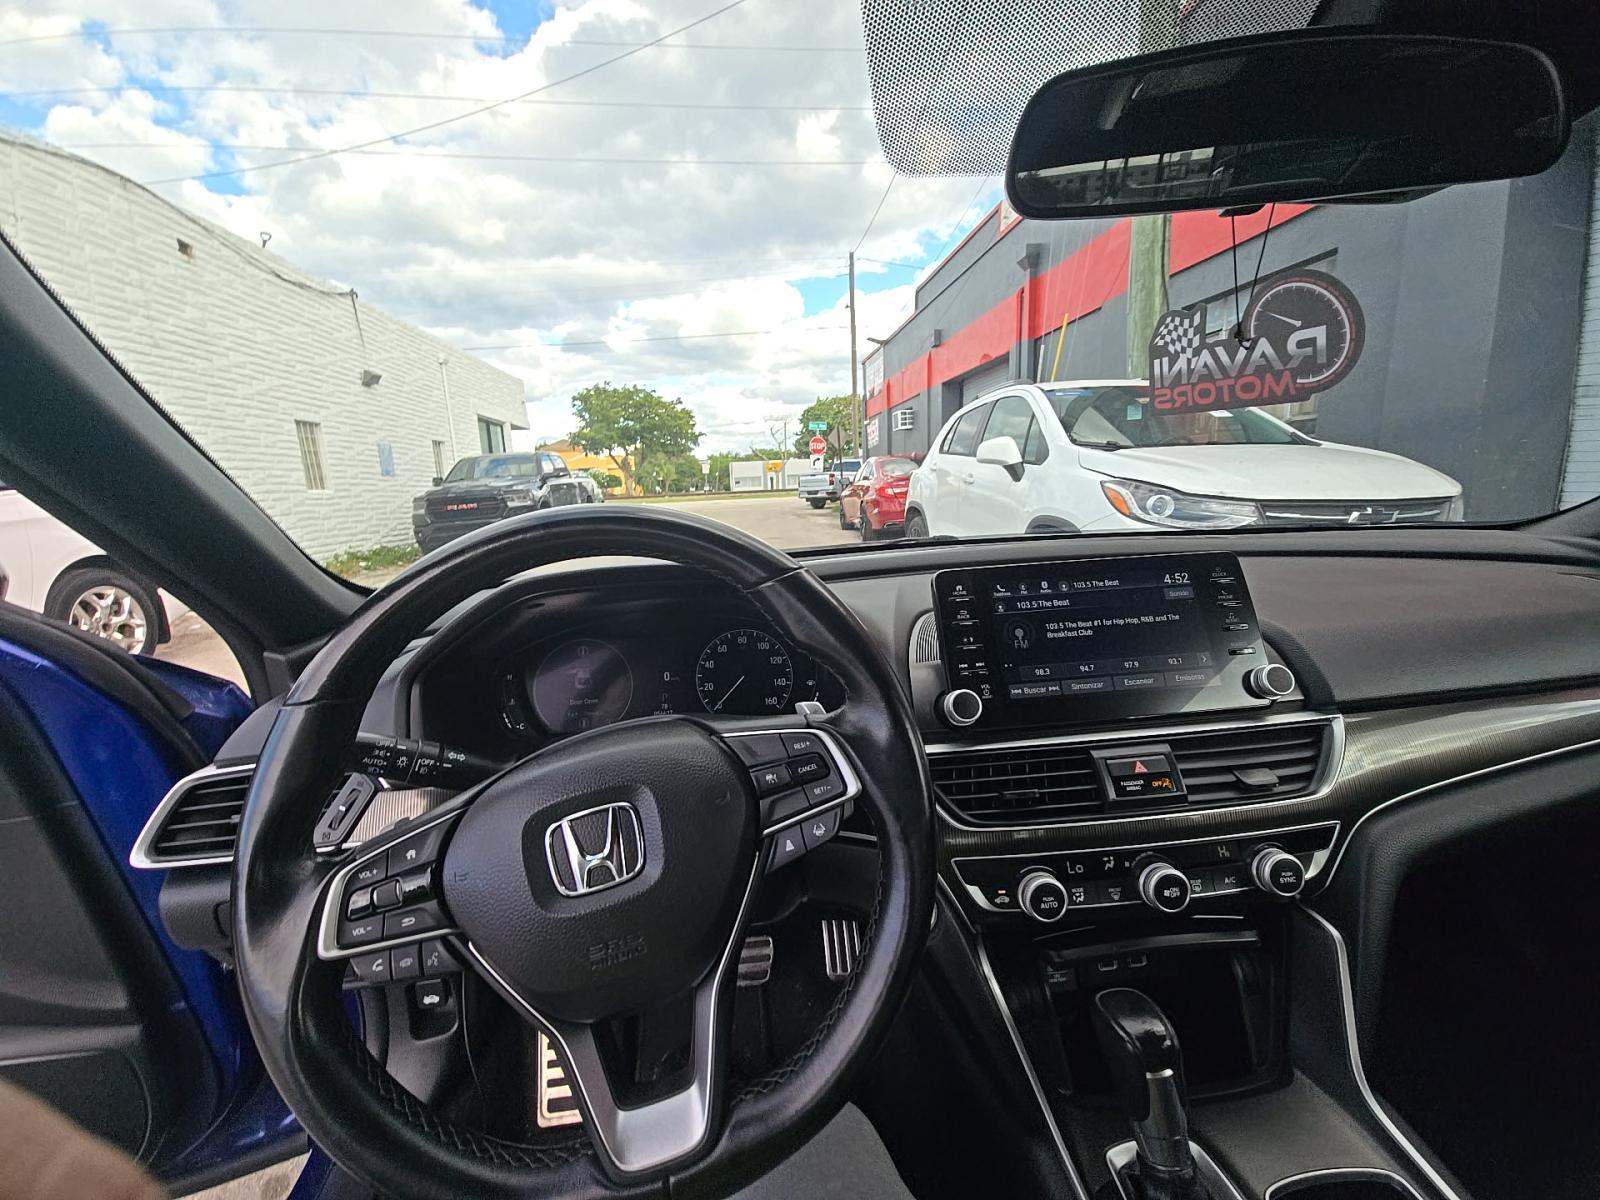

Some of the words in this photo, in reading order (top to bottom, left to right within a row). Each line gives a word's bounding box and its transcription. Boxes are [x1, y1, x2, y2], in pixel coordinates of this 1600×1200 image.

[810, 442, 825, 450] STOP
[1164, 572, 1191, 584] 4:52
[1092, 580, 1104, 588] The
[1016, 601, 1037, 610] 103.5
[1039, 600, 1053, 608] The
[1053, 599, 1070, 607] Beat
[1045, 621, 1064, 630] 103.5
[1065, 621, 1077, 629] The
[1078, 620, 1093, 628] Beat
[1103, 618, 1113, 626] for
[1113, 618, 1125, 627] Hip
[1125, 617, 1141, 625] Hop,
[1167, 613, 1180, 621] The
[1046, 630, 1078, 639] Breakfast
[1078, 628, 1093, 637] Club
[737, 636, 748, 644] 80
[1014, 640, 1029, 649] FM
[717, 644, 728, 653] 60
[757, 641, 770, 651] 100
[704, 660, 715, 669] 40
[769, 656, 783, 665] 120
[1080, 664, 1095, 672] 94.7
[663, 671, 671, 681] 0
[704, 682, 714, 691] 20
[774, 678, 786, 687] 140
[1071, 682, 1104, 690] Sintonizar
[1023, 685, 1047, 695] Buscar
[764, 697, 778, 706] 160
[362, 757, 384, 766] AUTO
[420, 758, 435, 766] OFF
[798, 763, 817, 774] CANCEL
[1224, 876, 1236, 885] A/C
[1279, 876, 1297, 884] SYNC
[1040, 901, 1058, 909] AUTO
